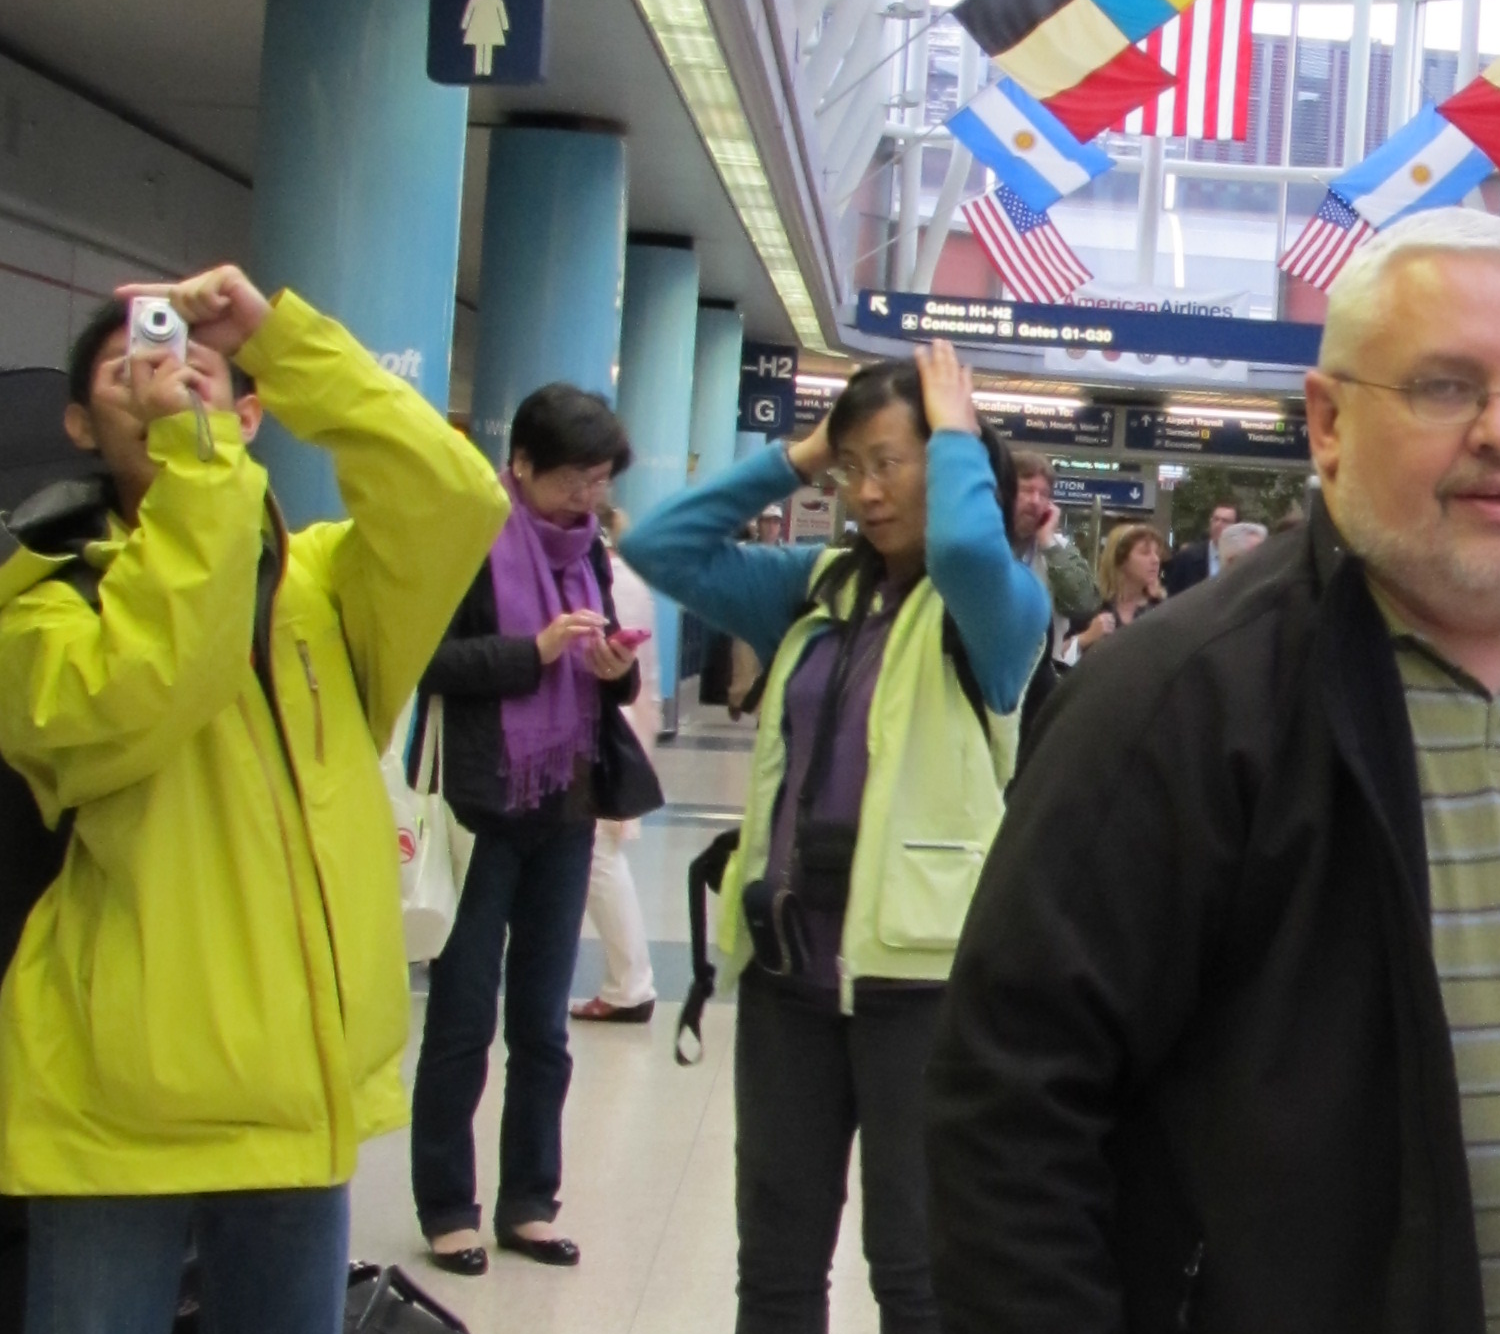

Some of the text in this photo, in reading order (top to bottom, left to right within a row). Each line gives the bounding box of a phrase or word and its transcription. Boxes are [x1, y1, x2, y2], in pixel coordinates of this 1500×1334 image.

[925, 301, 1013, 320] Gates H1-H2
[920, 317, 995, 335] Concourse
[1018, 323, 1059, 339] Gates
[1061, 327, 1113, 343] G1-G30
[755, 399, 775, 422] G
[1024, 403, 1056, 416] Down
[1166, 415, 1195, 426] Airport
[1196, 417, 1224, 427] Transit
[1240, 420, 1275, 431] Terminal
[1165, 427, 1199, 437] Terminal
